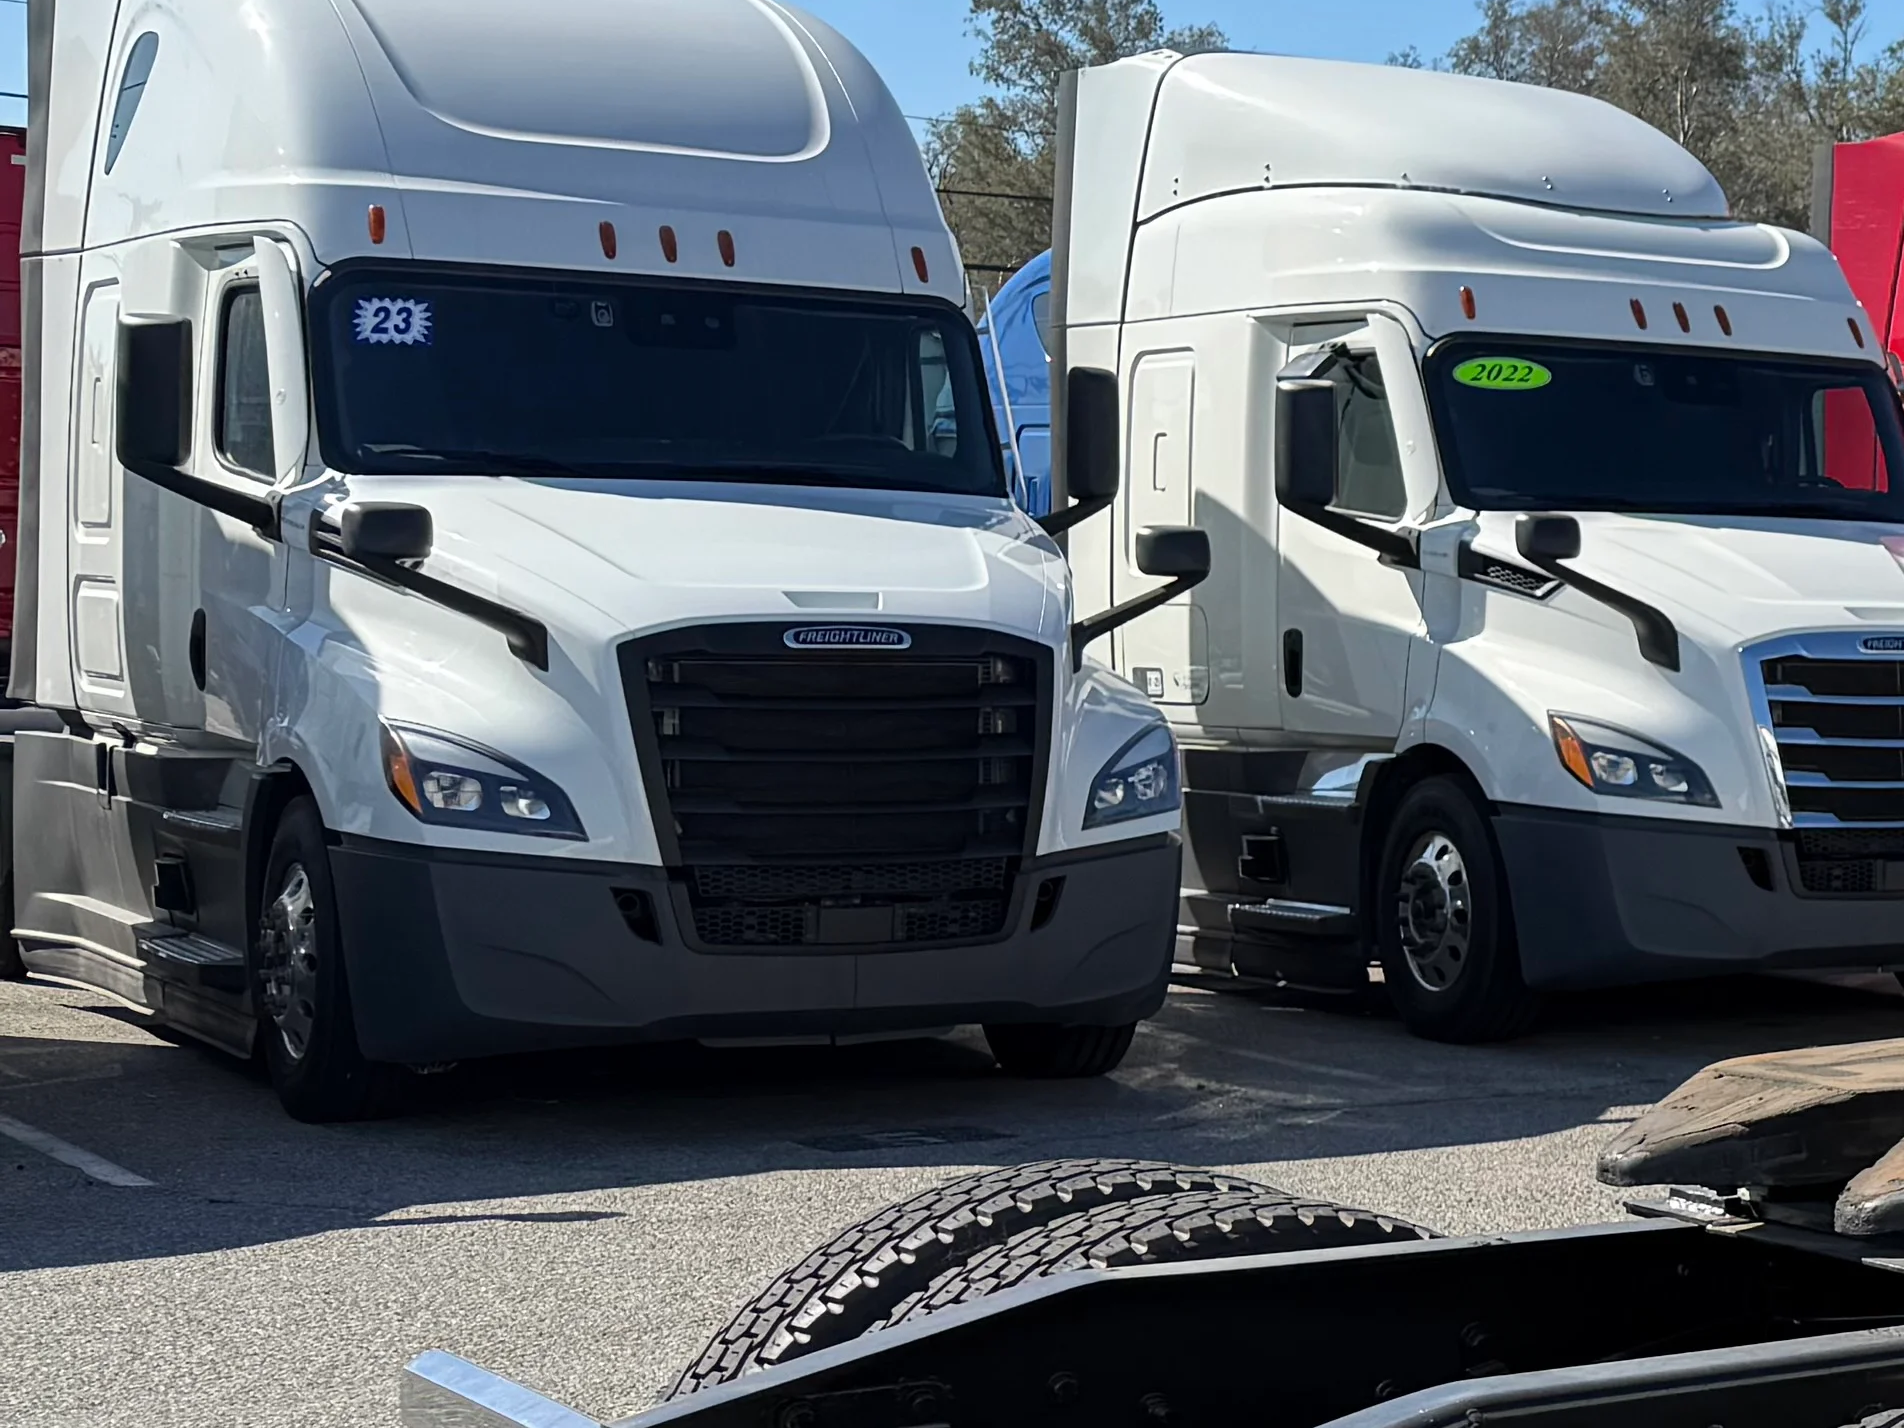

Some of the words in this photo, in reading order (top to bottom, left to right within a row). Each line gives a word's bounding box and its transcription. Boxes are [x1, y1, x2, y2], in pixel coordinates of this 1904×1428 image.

[370, 306, 413, 335] 23
[1470, 364, 1533, 382] 2022
[799, 630, 898, 643] FREIGHTLINER
